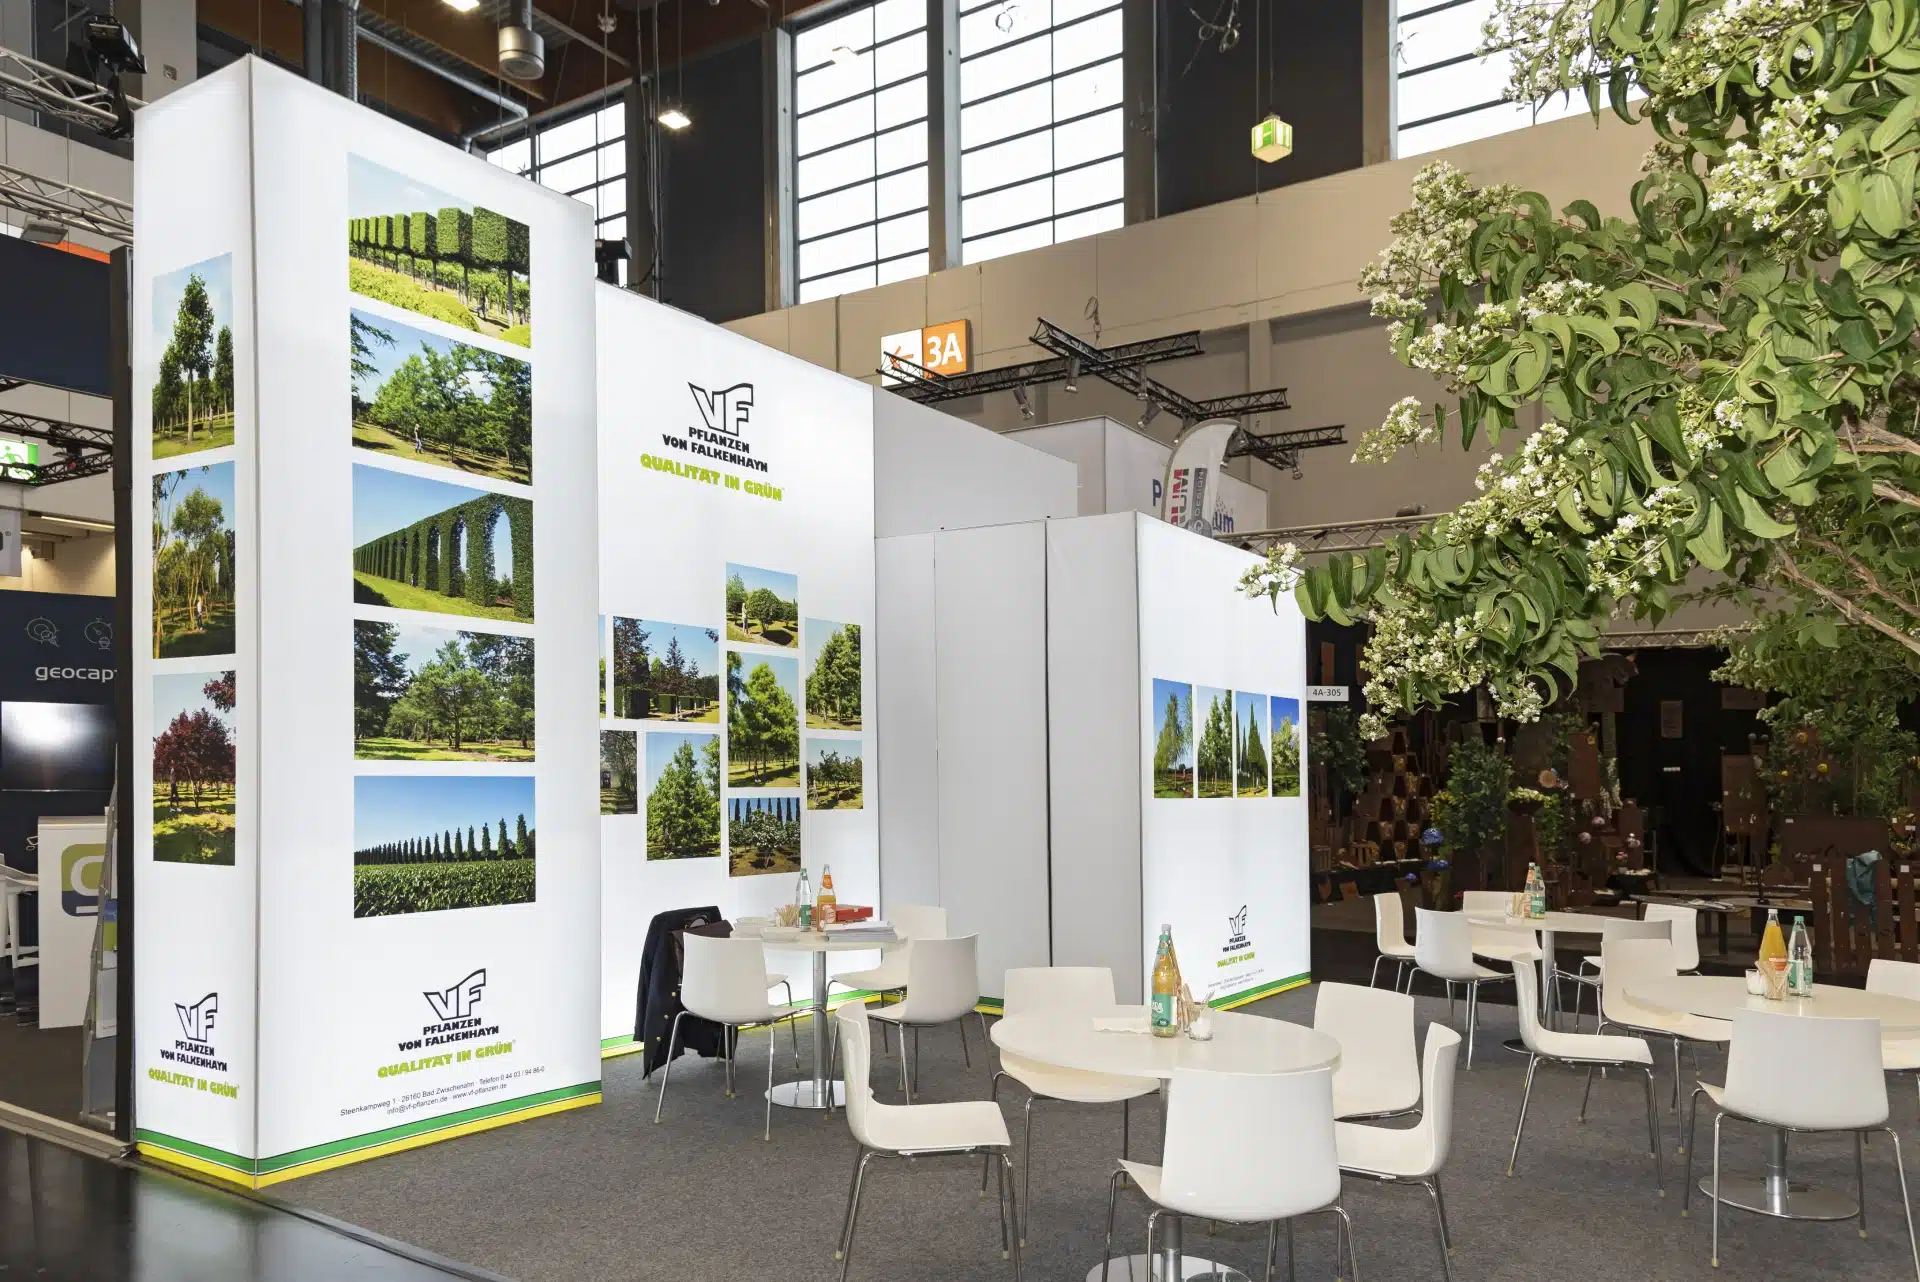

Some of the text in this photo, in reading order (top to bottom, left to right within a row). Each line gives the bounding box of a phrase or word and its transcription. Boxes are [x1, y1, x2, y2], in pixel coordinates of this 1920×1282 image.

[926, 332, 963, 368] 3A
[687, 381, 754, 437] VF
[662, 434, 768, 473] VON FALKENHAYN
[688, 426, 750, 453] PFLANZEN
[724, 473, 740, 490] IN
[744, 479, 782, 501] GRÜN
[1194, 471, 1204, 517] DESIGN
[35, 666, 114, 683] geocap
[1312, 688, 1342, 697] 4A-305
[1228, 904, 1247, 936] VF
[423, 968, 487, 1022] VF
[174, 992, 218, 1043] VF
[423, 1017, 482, 1036] PFLANZEN
[175, 1039, 215, 1056] PFLANZEN
[398, 1025, 500, 1052] VON FALKENHAYN
[456, 1050, 472, 1063] IN
[475, 1040, 513, 1059] GRÜN
[160, 1049, 228, 1072] VON FALKENHAYN
[197, 1078, 208, 1091] IN
[210, 1081, 237, 1099] GRÜN
[340, 1100, 391, 1117] Steenkampweg
[422, 1089, 435, 1098] Bad
[436, 1081, 475, 1094] Zwischenahn
[479, 1075, 500, 1084] Telefon
[386, 1083, 507, 1115] info@vf-pflanzen.de www.vf-pflanzen.de
